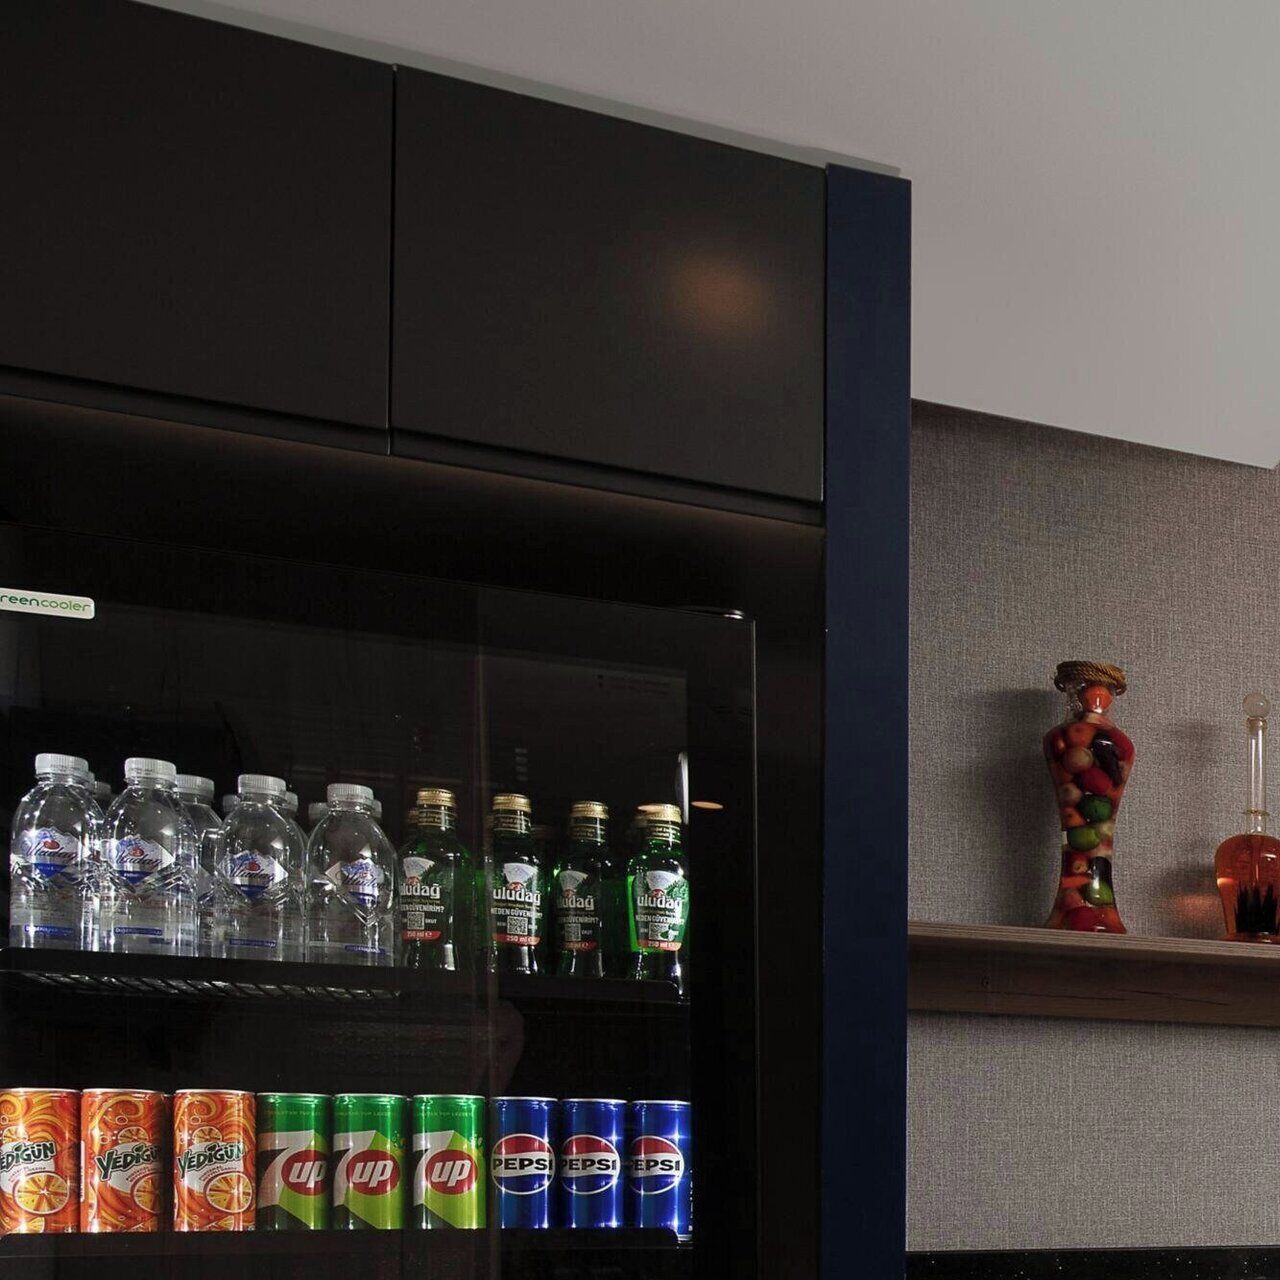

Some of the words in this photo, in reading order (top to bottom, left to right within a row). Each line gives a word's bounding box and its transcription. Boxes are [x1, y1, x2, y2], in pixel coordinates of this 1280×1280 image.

[0, 594, 91, 612] reencooler
[400, 883, 441, 899] ludağ
[0, 1142, 56, 1173] EDİGÜN
[493, 1157, 554, 1171] PEPSI
